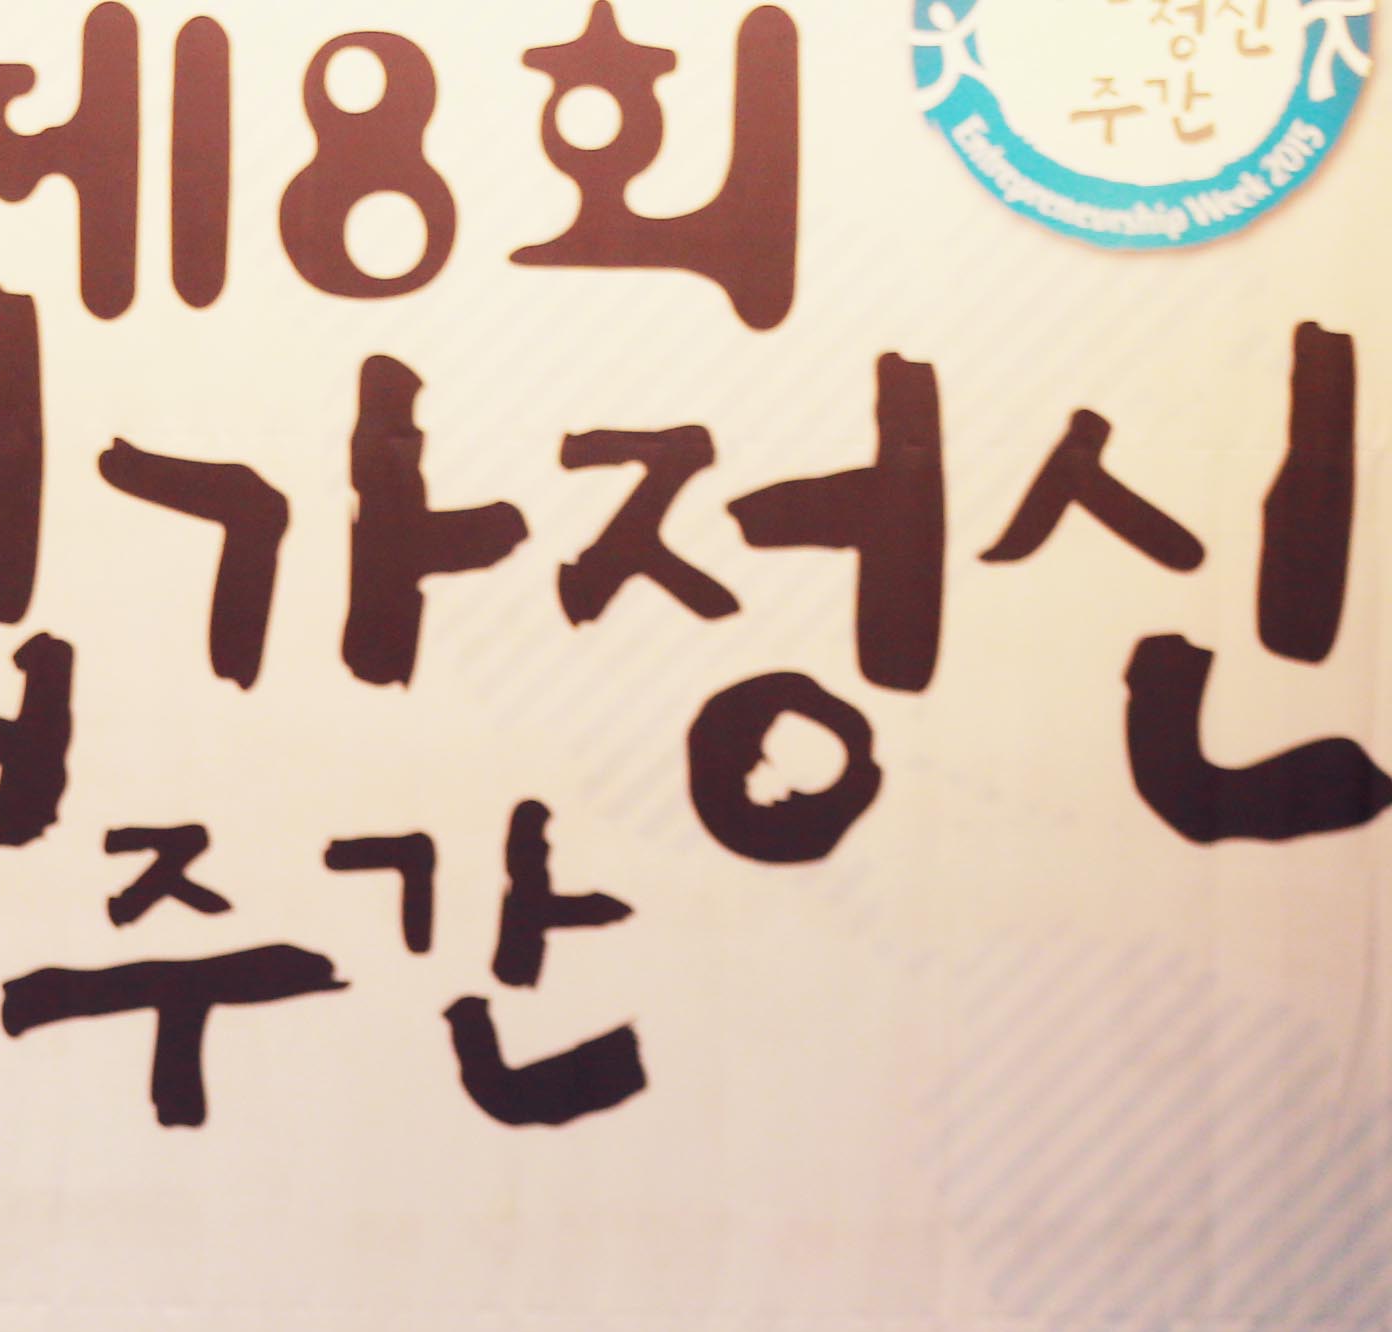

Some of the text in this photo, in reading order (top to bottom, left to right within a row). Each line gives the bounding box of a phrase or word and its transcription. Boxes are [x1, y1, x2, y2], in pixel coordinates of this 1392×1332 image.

[1068, 72, 1216, 146] 주간
[1260, 118, 1327, 188] 2015
[0, 798, 650, 1130] 주간
